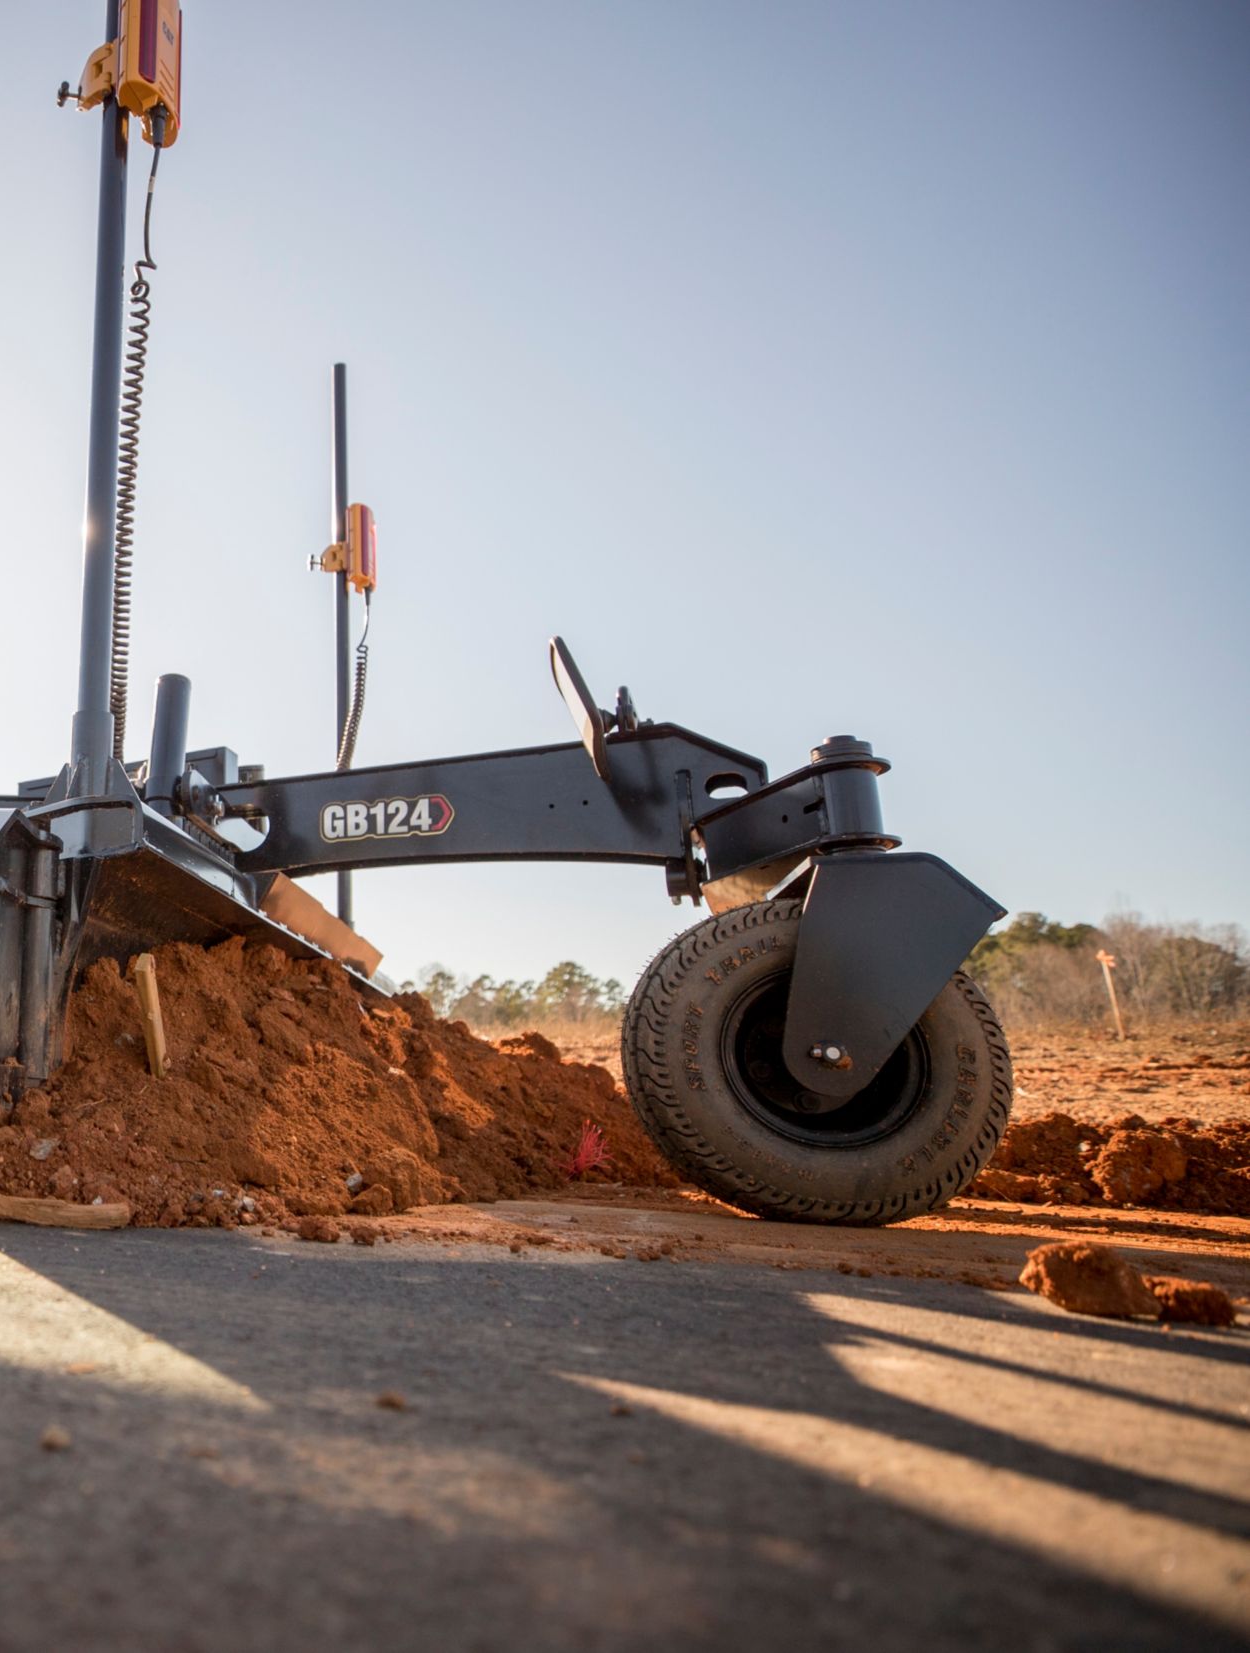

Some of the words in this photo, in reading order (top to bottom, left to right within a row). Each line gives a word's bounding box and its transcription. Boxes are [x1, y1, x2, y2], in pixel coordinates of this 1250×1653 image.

[323, 798, 432, 838] GB124
[682, 1003, 706, 1090] SPORT
[897, 1044, 977, 1177] CARLISLE
